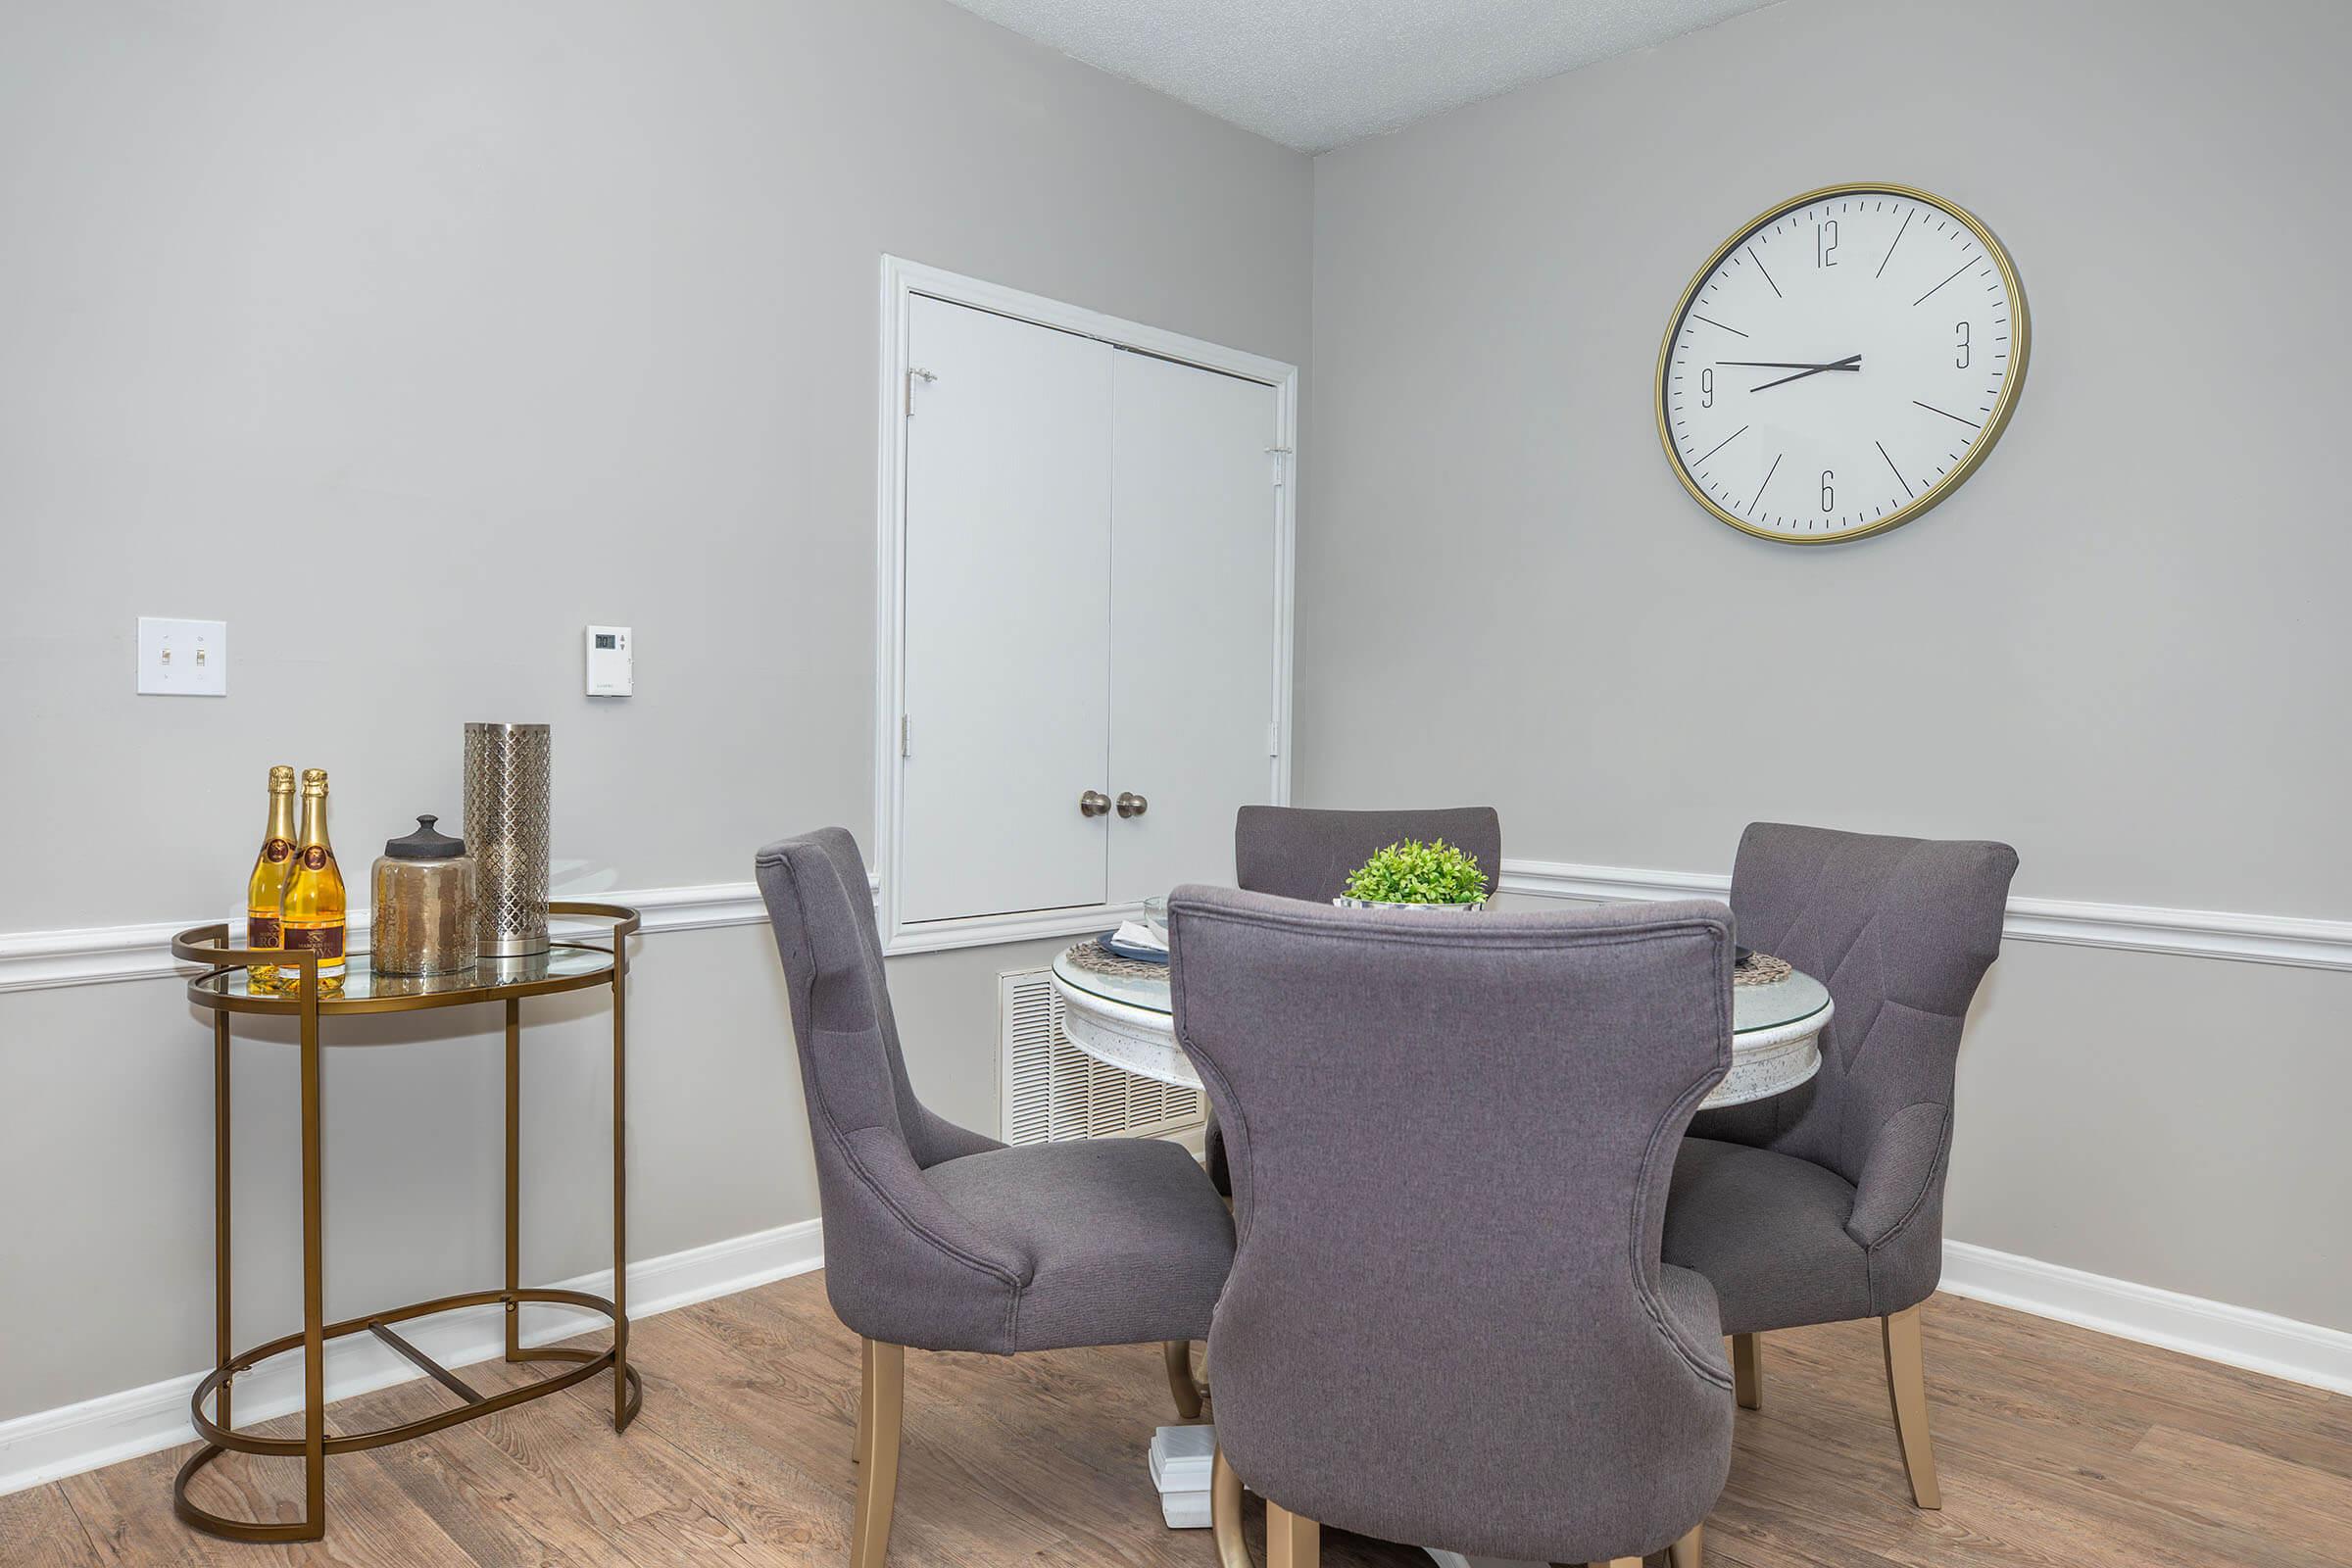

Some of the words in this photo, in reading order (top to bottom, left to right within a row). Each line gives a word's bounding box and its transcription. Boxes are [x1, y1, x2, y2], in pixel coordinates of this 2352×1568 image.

[1818, 220, 1838, 268] 12
[1956, 321, 1970, 368] 3
[1701, 368, 1713, 409] 9
[1821, 470, 1834, 513] 6
